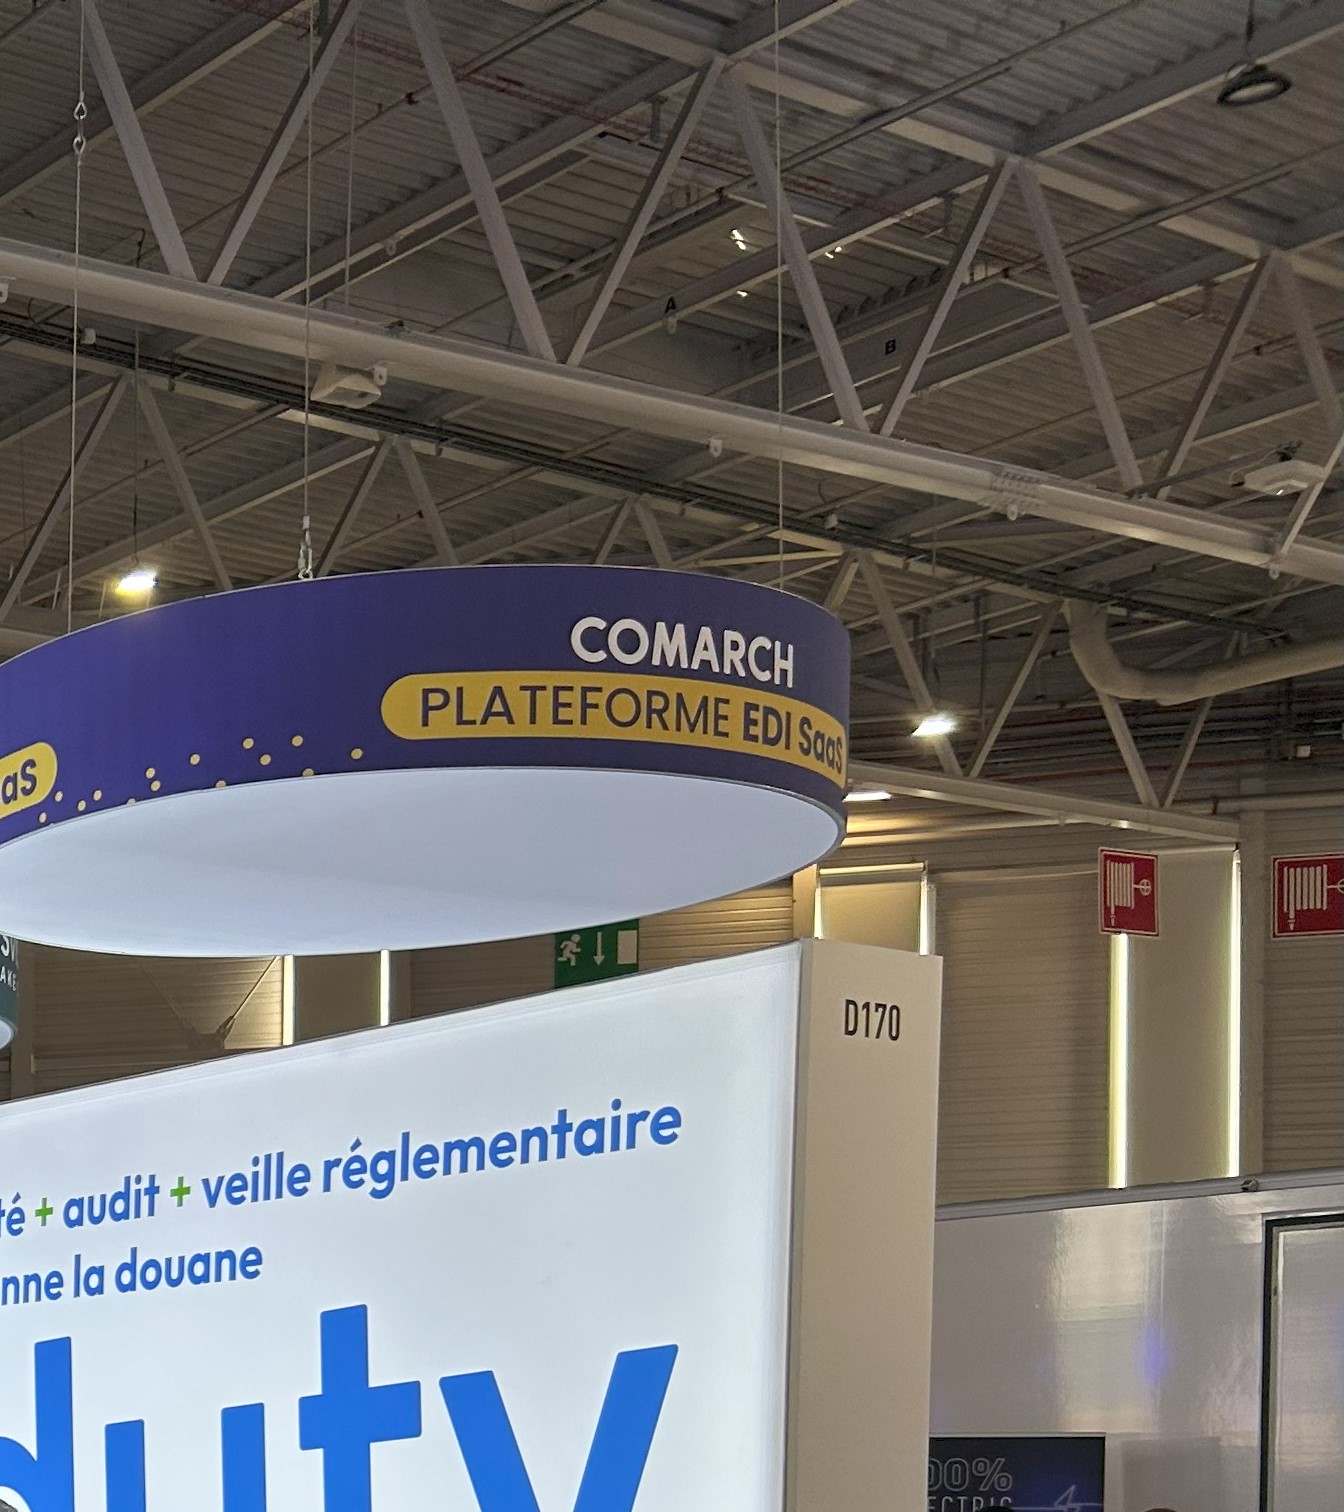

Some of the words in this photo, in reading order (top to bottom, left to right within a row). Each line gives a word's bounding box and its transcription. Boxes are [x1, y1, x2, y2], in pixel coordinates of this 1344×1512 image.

[570, 616, 794, 688] COMARCH
[419, 684, 730, 738] PLATEFORME
[743, 701, 791, 751] EDI
[798, 716, 843, 775] SaaS
[844, 998, 901, 1042] D170
[35, 1197, 53, 1227] +
[62, 1173, 161, 1230] audit
[169, 1175, 192, 1208] +
[201, 1150, 312, 1210] veille
[321, 1098, 683, 1200] réglementaire
[73, 1254, 105, 1297] la
[114, 1245, 263, 1298] douane
